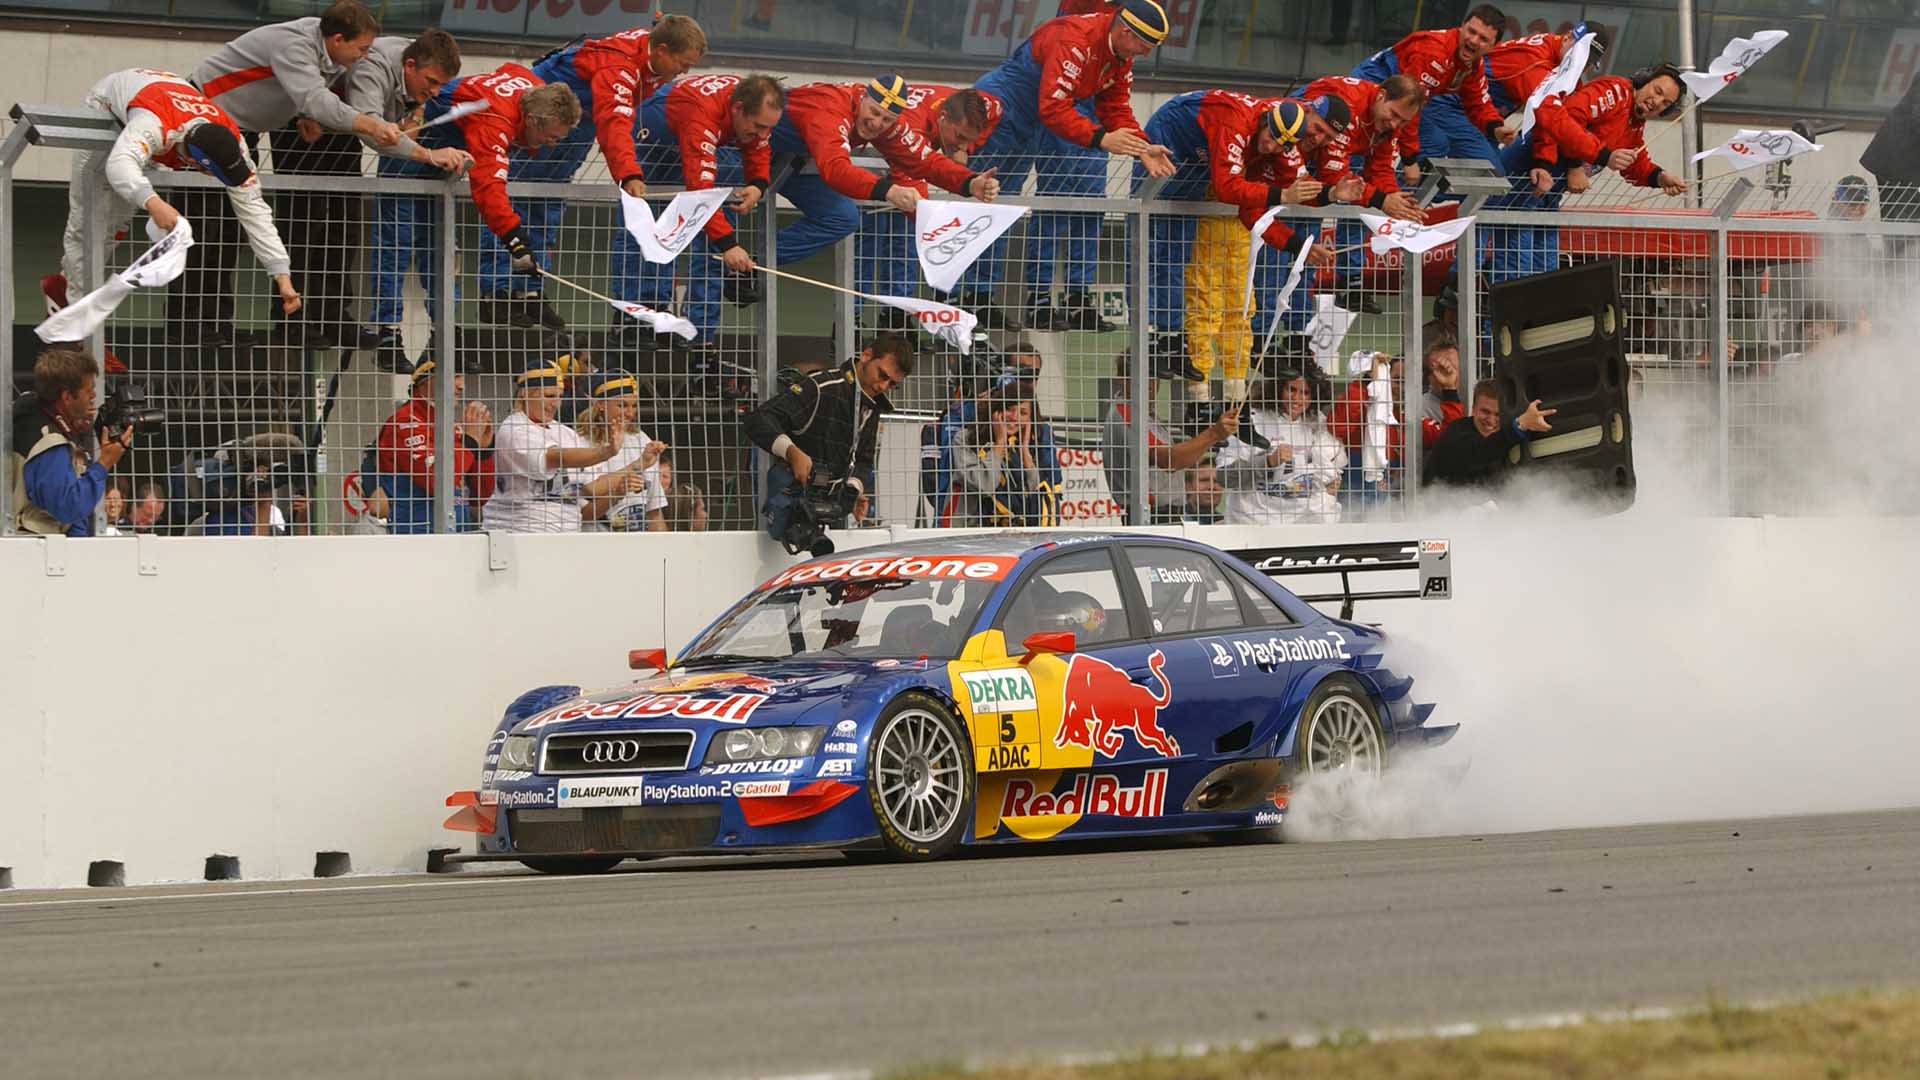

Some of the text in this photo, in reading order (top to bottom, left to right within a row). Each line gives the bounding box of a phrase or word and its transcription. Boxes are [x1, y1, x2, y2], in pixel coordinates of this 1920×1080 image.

[1058, 448, 1102, 468] OSC
[1066, 479, 1097, 490] DTM
[1061, 499, 1120, 520] OSCH
[771, 557, 999, 586] vodafone
[1423, 577, 1447, 597] ABT
[967, 676, 1034, 703] DEKRA
[624, 693, 769, 724] Bull
[1001, 713, 1016, 742] 5
[712, 759, 803, 775] DUNLOP
[988, 745, 1030, 769] ADAC
[816, 759, 856, 777] ABT
[570, 786, 639, 798] BLAUPUNKT
[746, 783, 782, 795] Castrol
[1001, 768, 1169, 817] Red Bull
